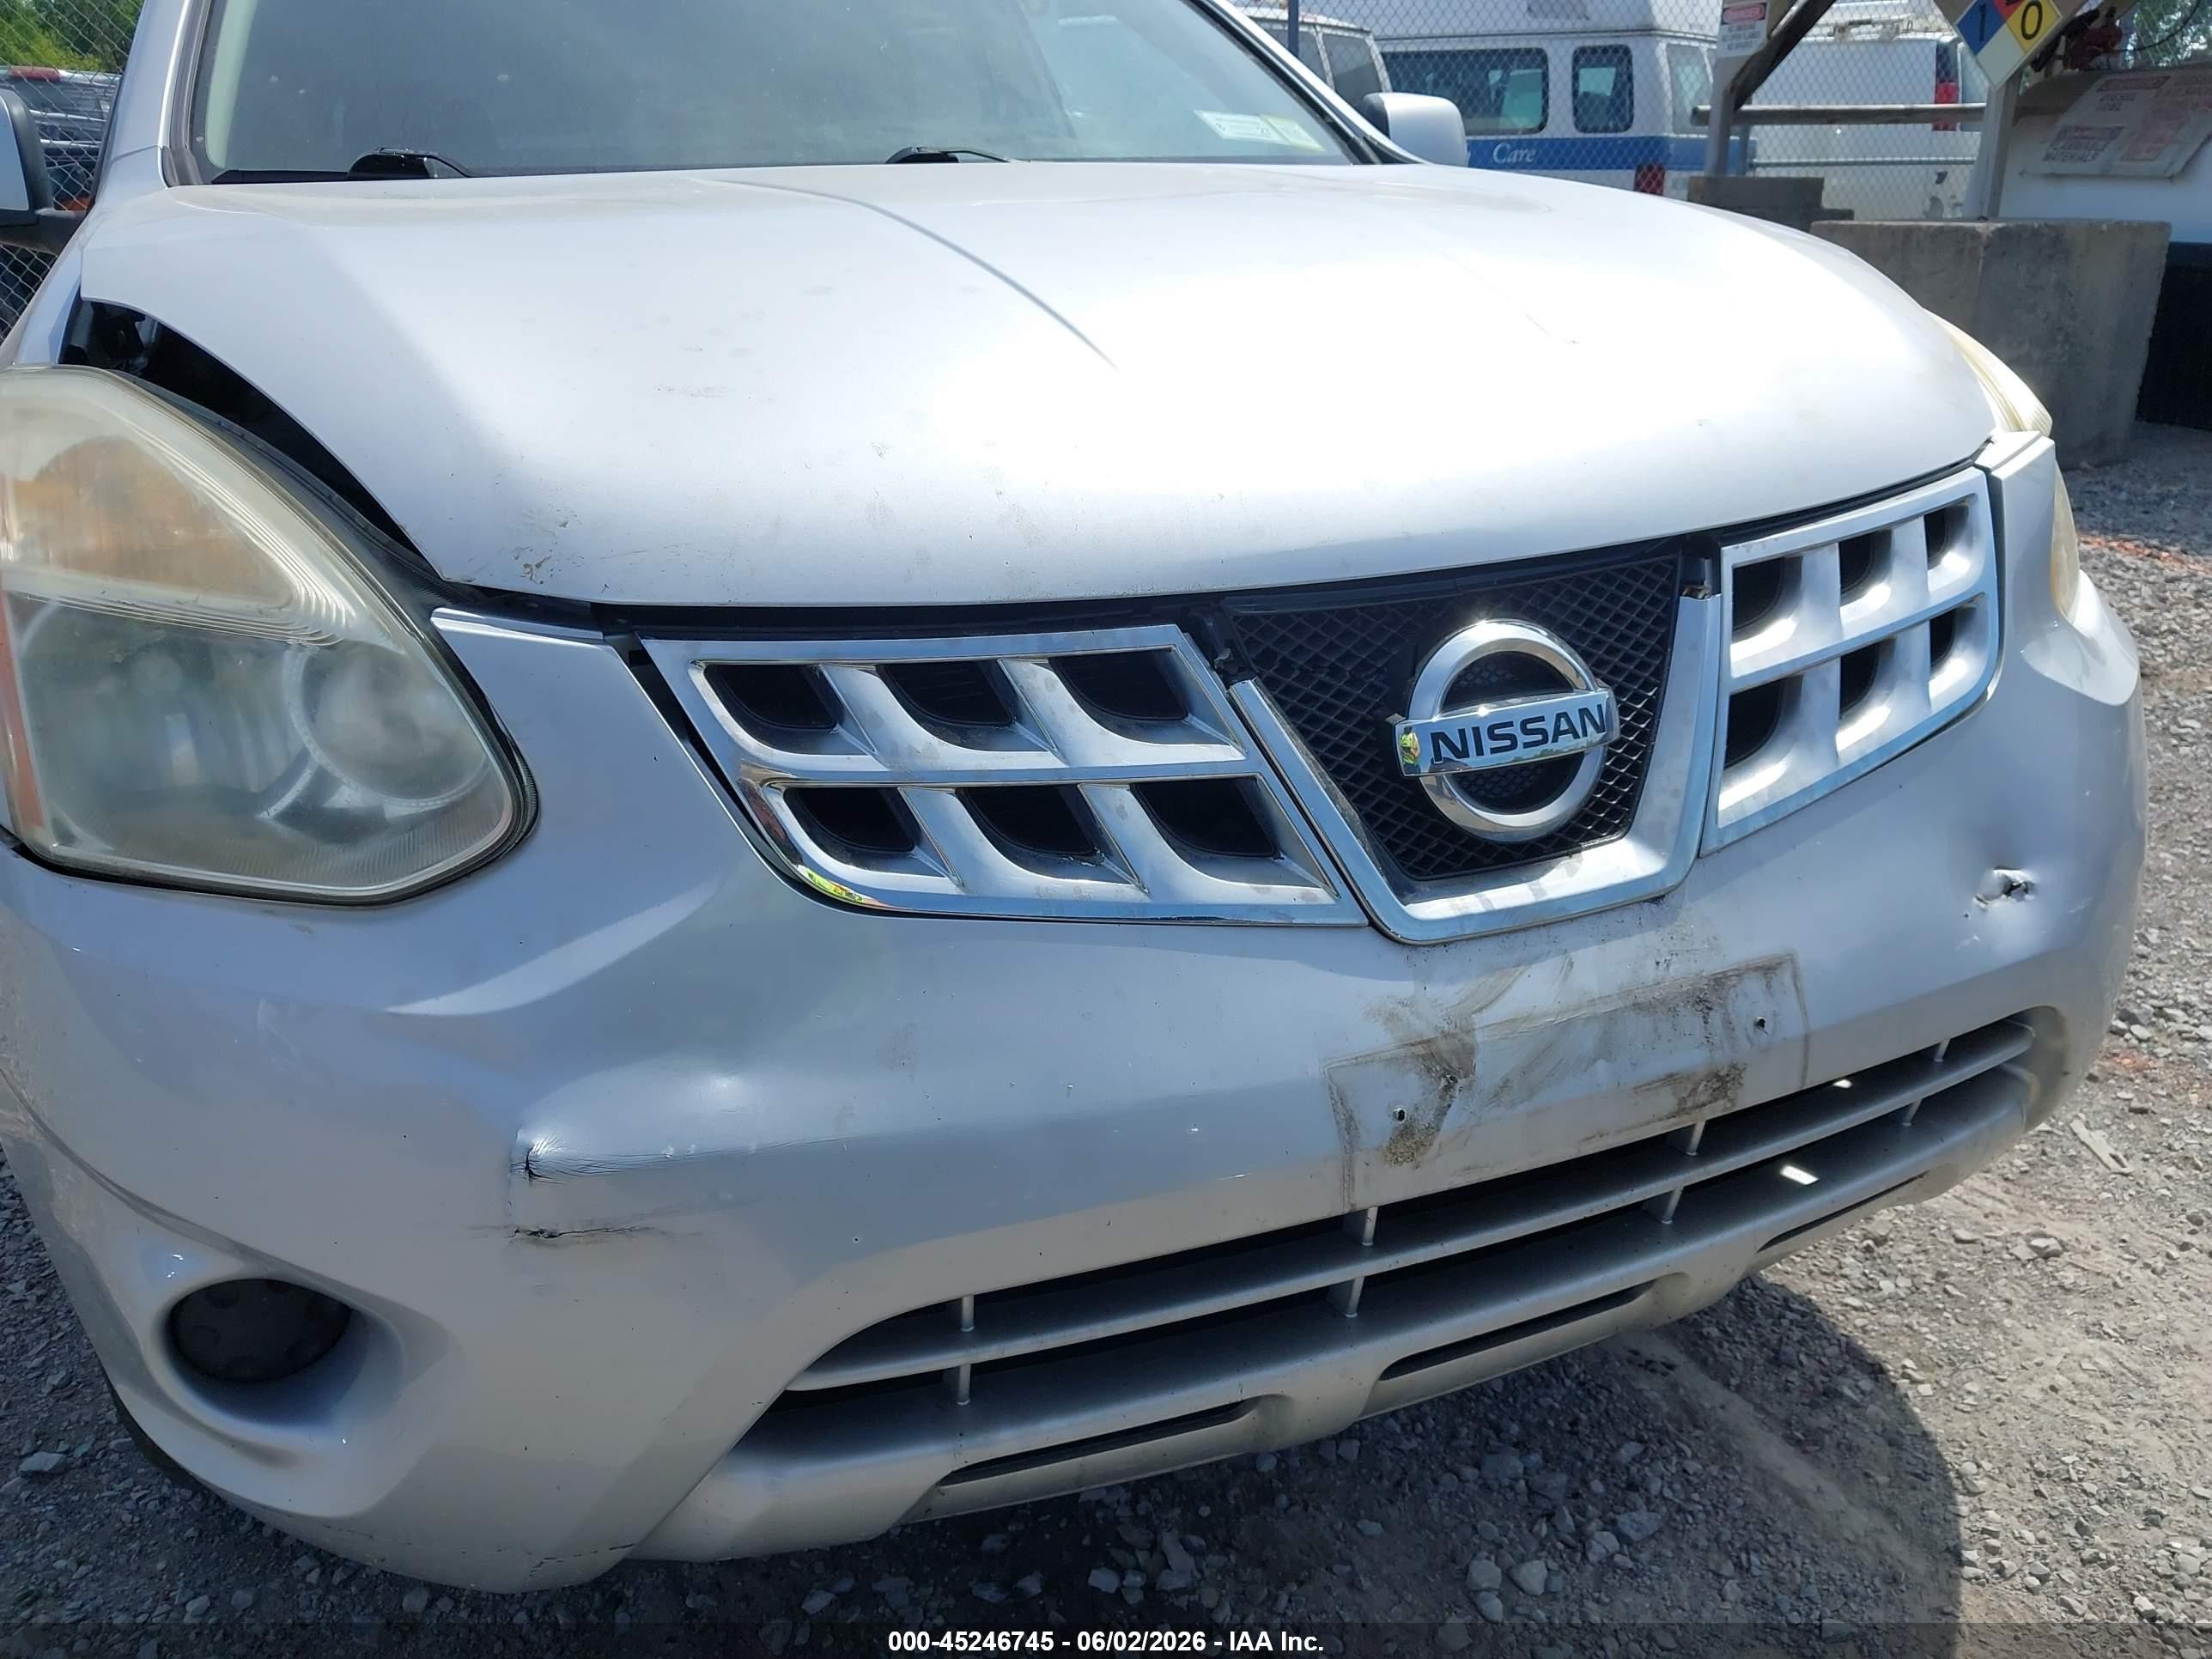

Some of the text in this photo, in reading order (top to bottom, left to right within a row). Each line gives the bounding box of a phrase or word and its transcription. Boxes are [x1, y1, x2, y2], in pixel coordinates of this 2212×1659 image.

[1978, 3, 1986, 42] 1
[2021, 1, 2043, 40] 0
[1492, 142, 1537, 164] Care
[1430, 703, 1607, 763] NISSAN
